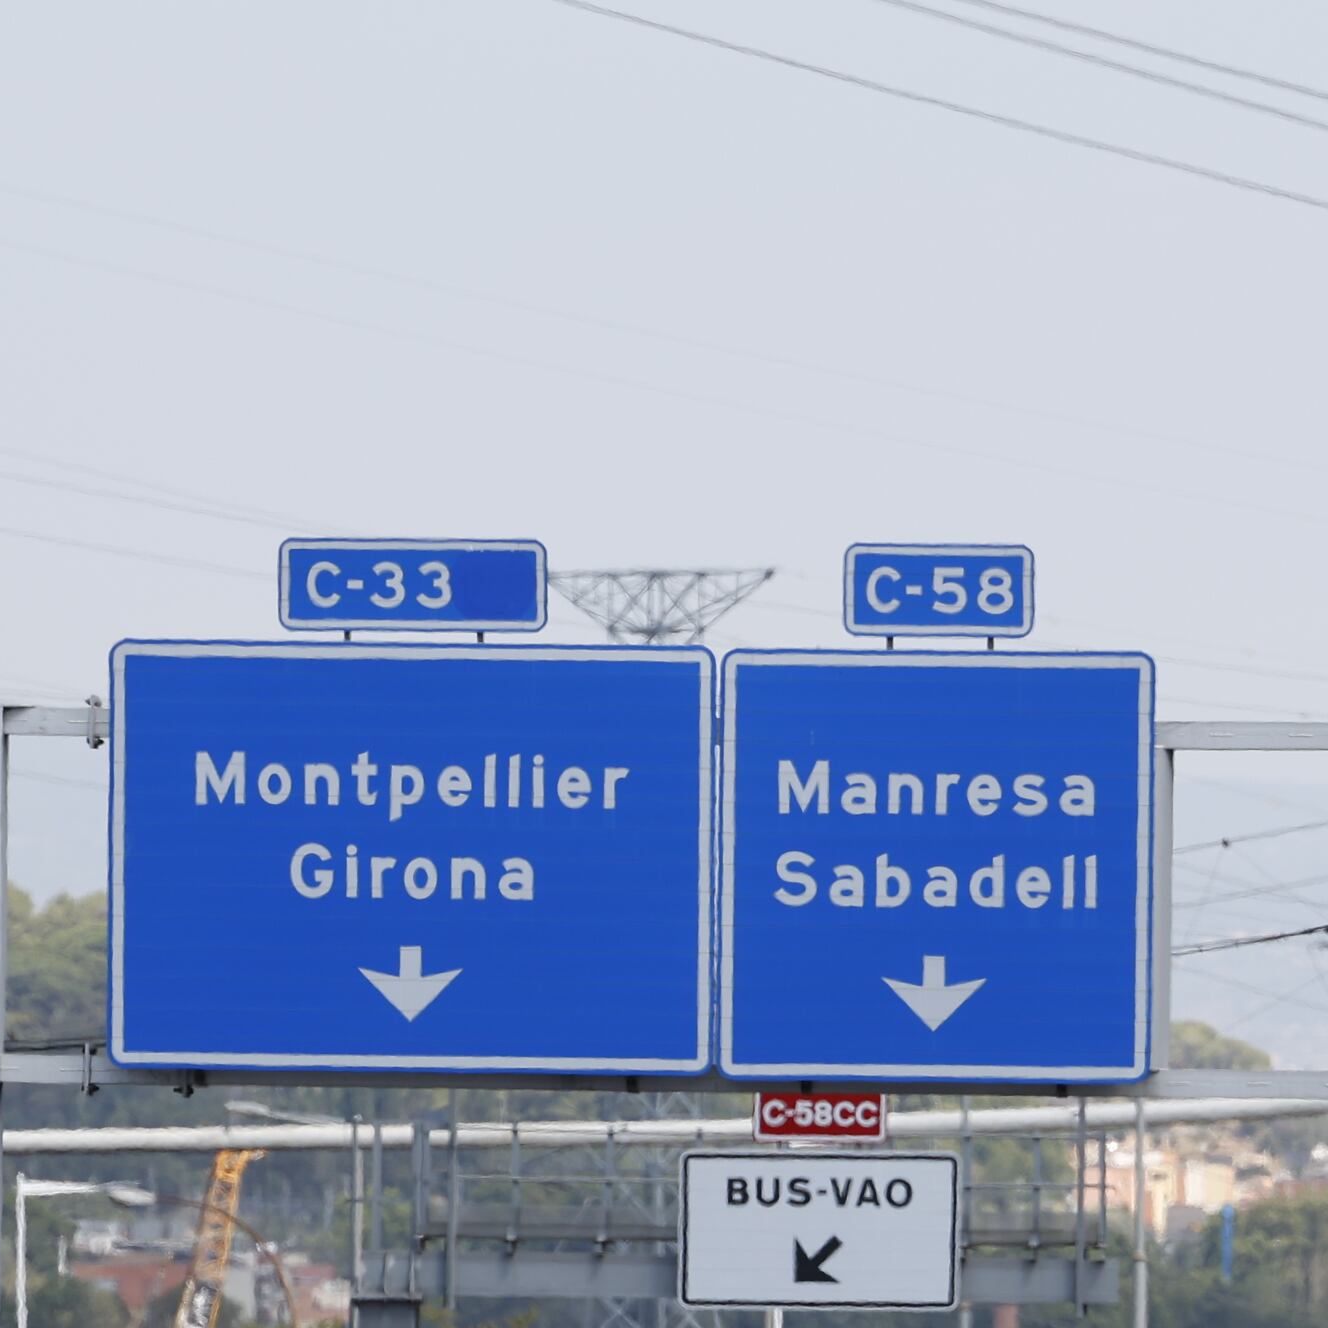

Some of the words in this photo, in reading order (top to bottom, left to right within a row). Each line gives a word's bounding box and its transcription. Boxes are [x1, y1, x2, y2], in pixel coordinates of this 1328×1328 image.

[306, 561, 452, 608] C-33
[865, 567, 1014, 614] C-58
[194, 750, 630, 822] Montpellier
[777, 760, 1096, 816] Manresa
[290, 844, 535, 901] Girona
[774, 851, 1098, 909] Sabadell
[762, 1099, 878, 1128] C-58CC
[726, 1177, 913, 1208] BUS-VAO
